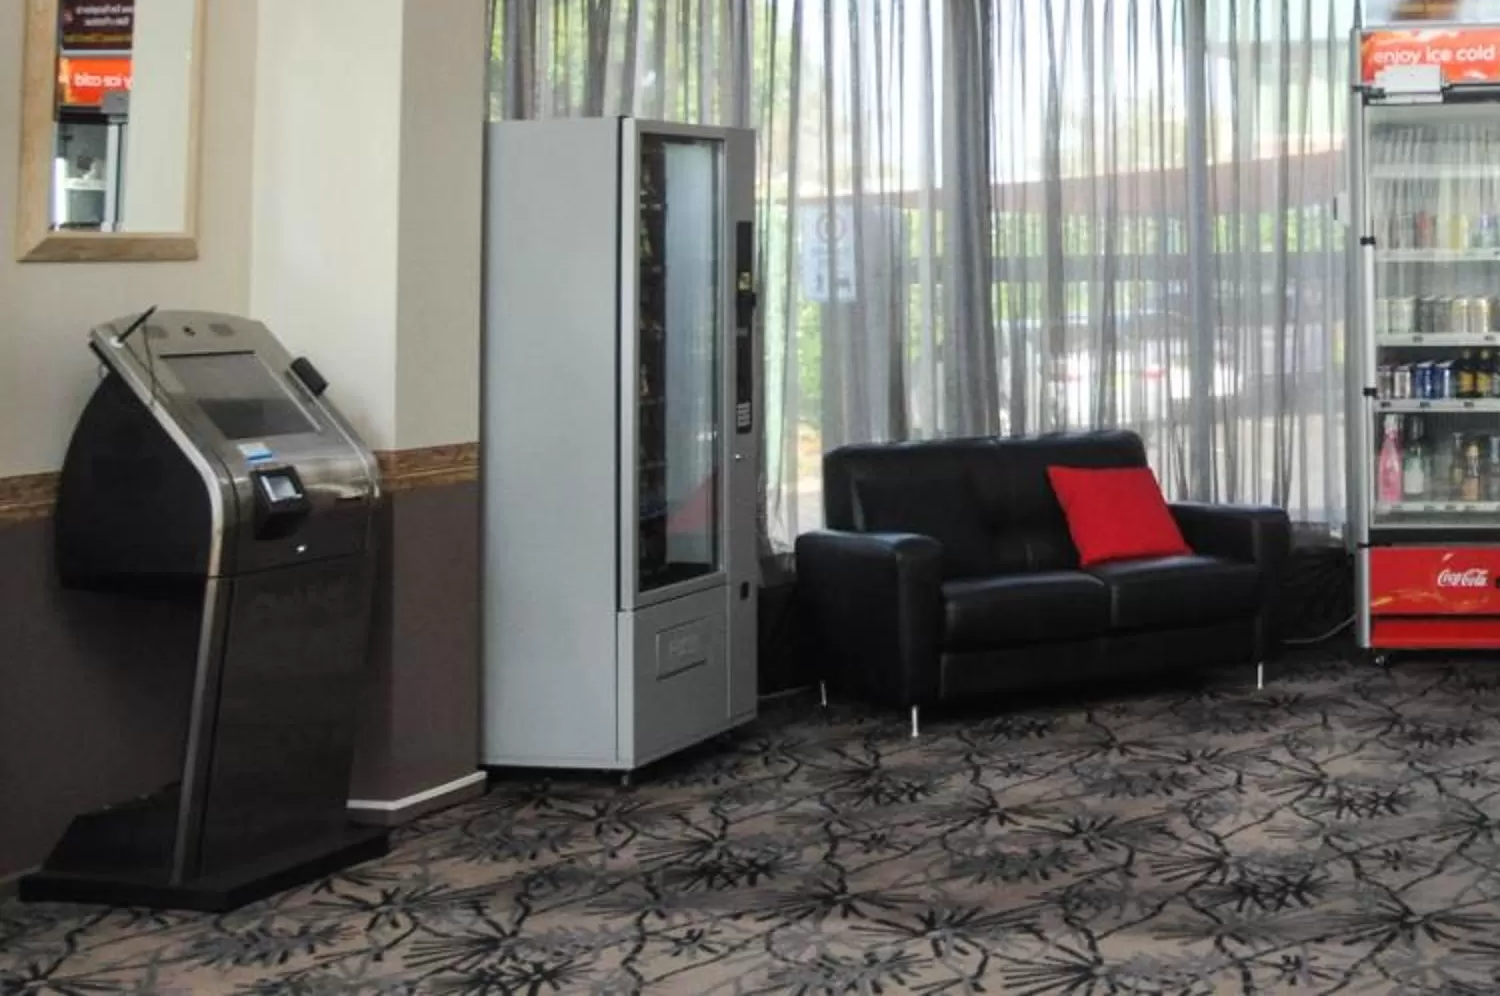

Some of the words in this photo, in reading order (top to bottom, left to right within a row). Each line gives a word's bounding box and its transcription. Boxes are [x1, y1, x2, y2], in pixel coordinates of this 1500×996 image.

[1373, 50, 1421, 65] enjoy
[1426, 45, 1452, 62] ice
[1456, 43, 1496, 61] cold
